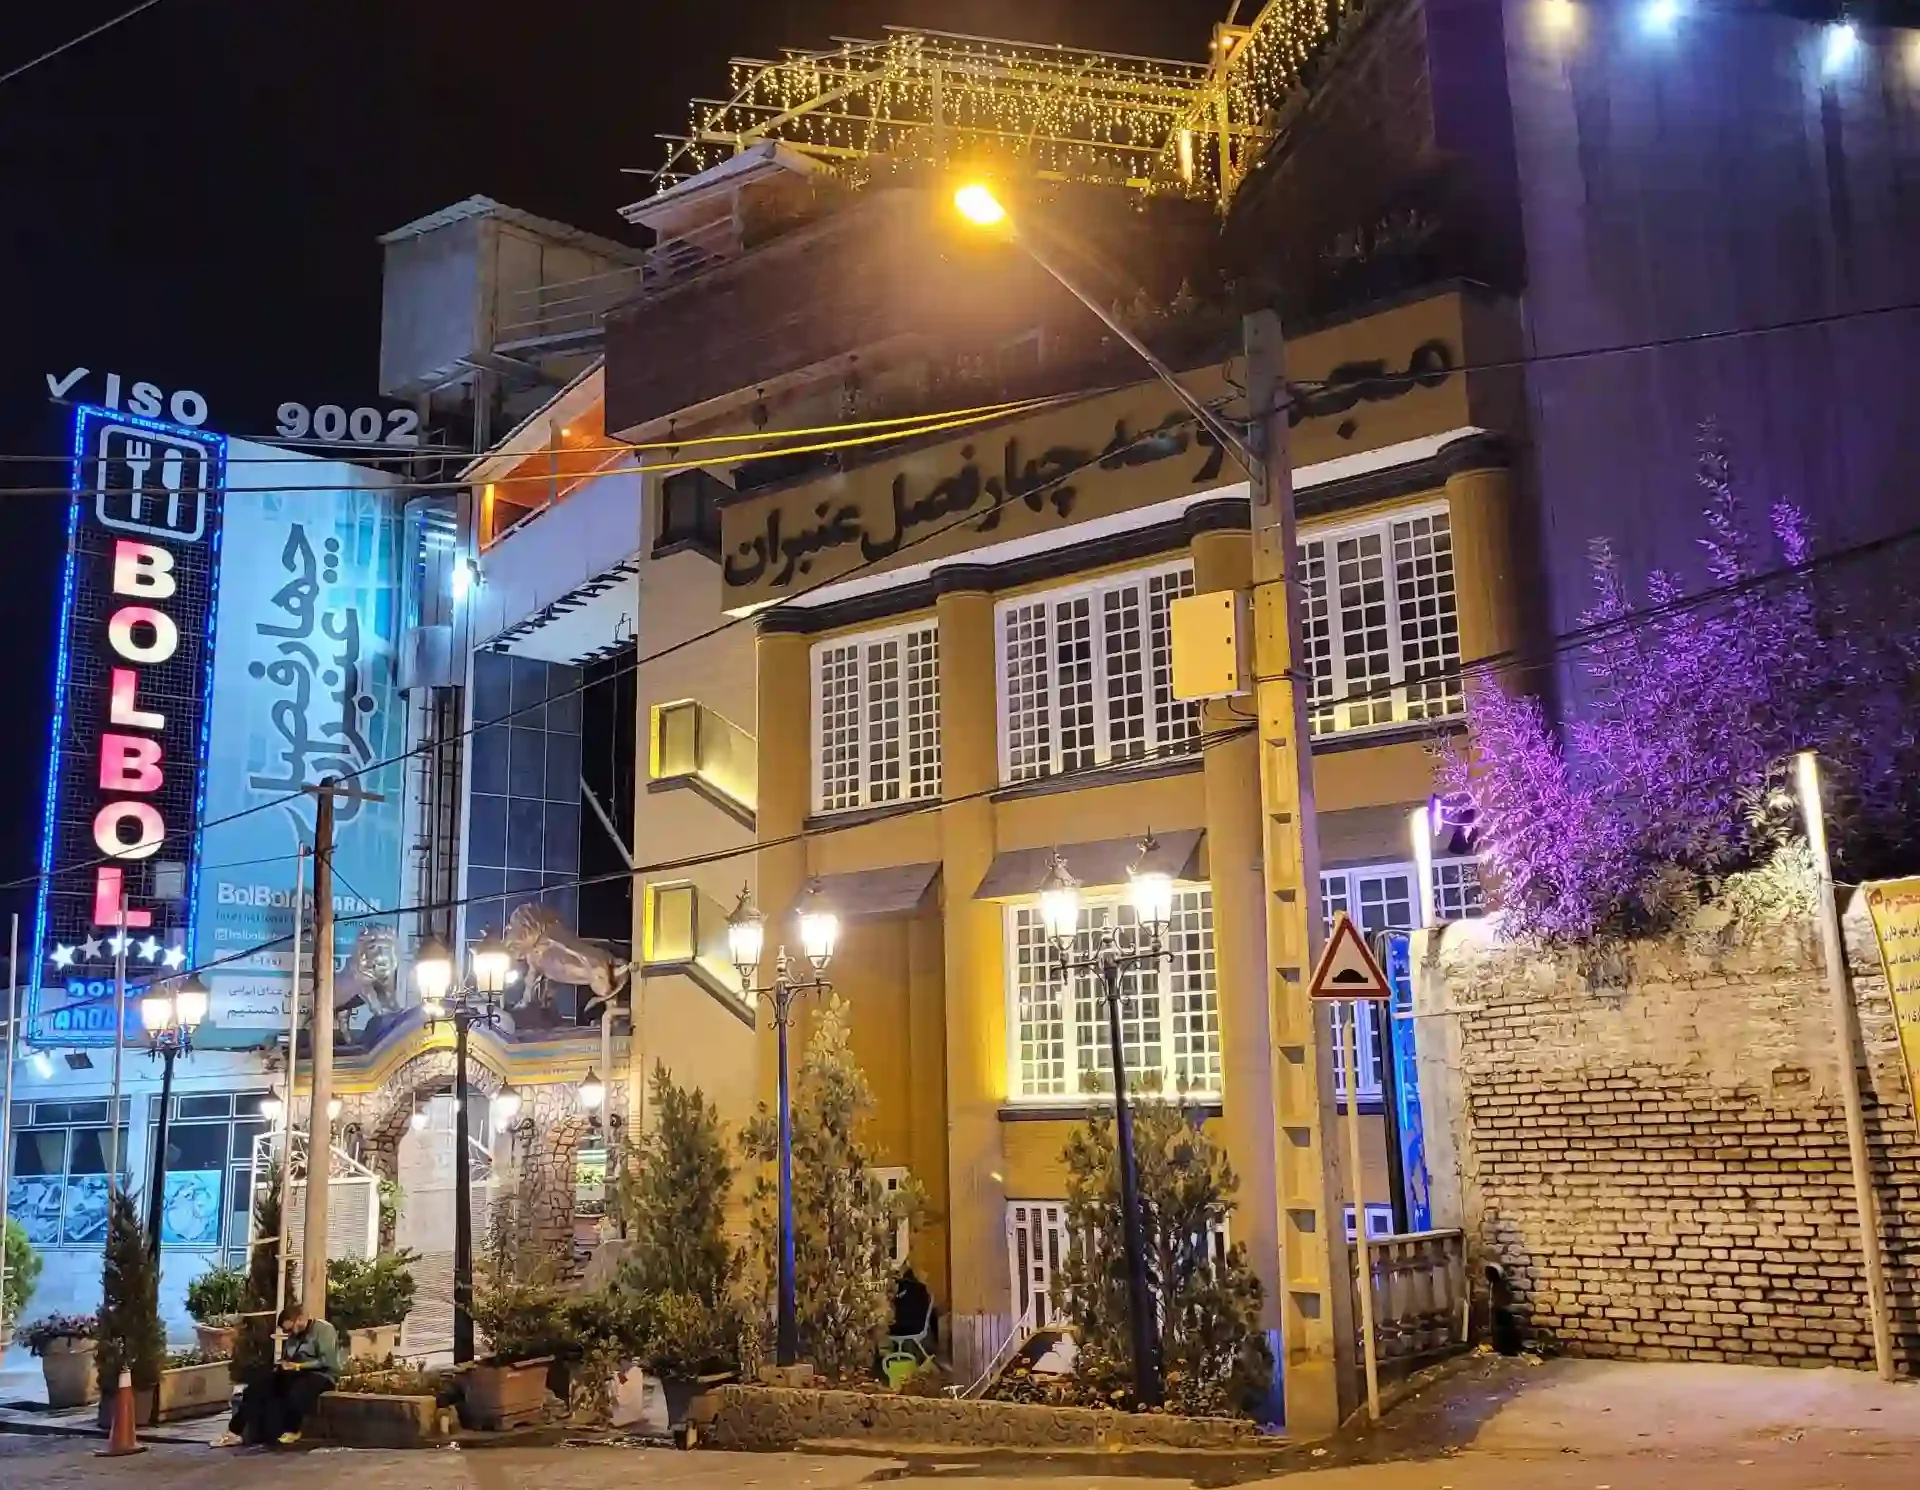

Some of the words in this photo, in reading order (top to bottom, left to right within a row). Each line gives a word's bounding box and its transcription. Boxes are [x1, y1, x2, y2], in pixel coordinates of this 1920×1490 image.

[105, 373, 208, 426] ISO
[276, 401, 419, 443] 9002
[861, 444, 980, 562] فصل
[972, 436, 1098, 533] چهار
[724, 501, 863, 587] عنبران
[93, 539, 178, 927] BOLBOL
[227, 1004, 280, 1020] هستیم
